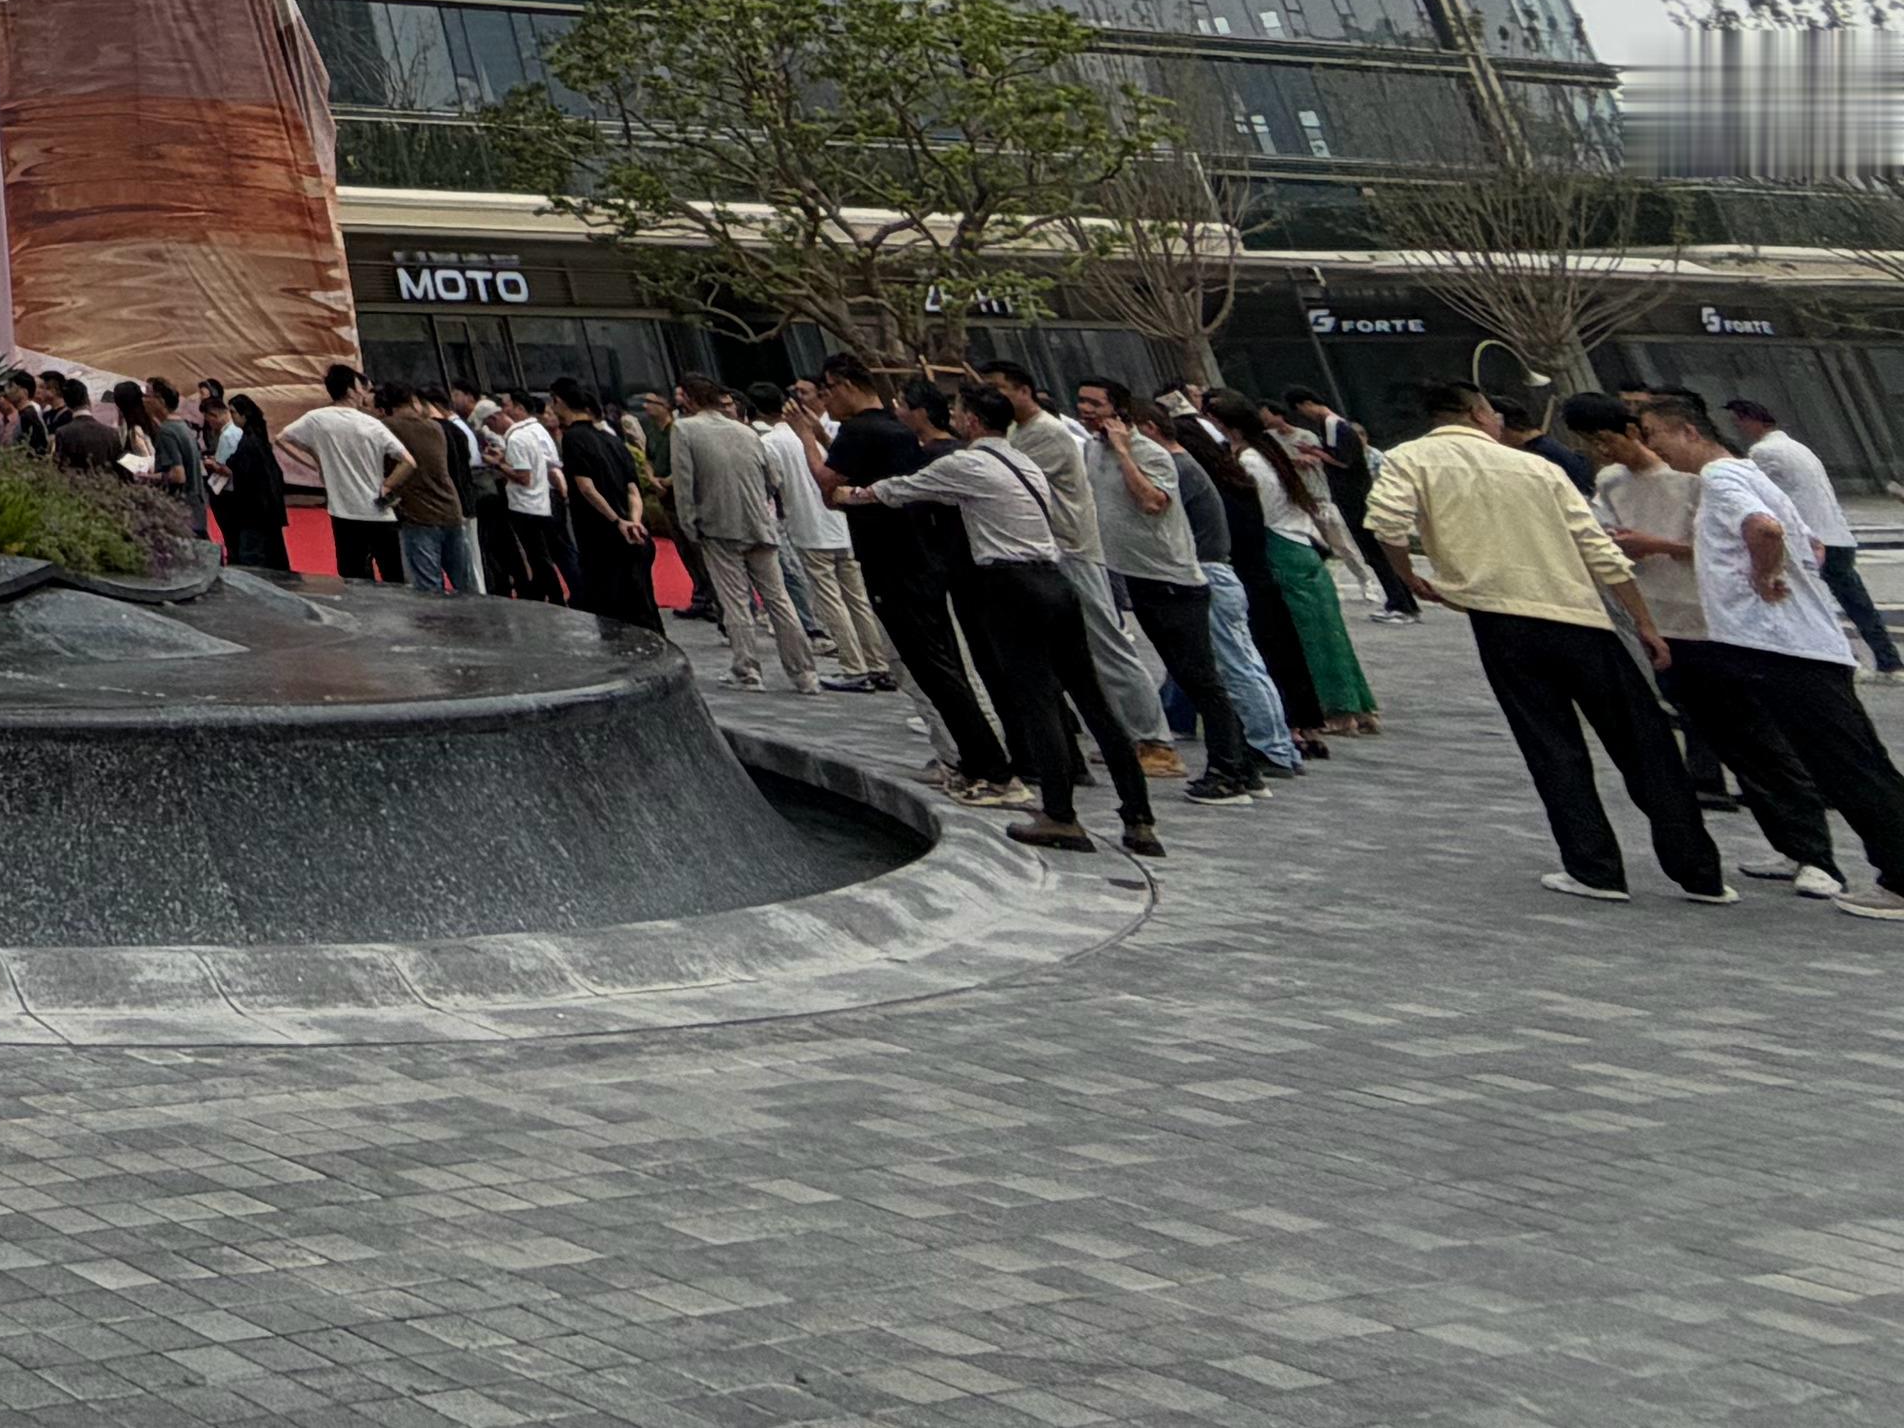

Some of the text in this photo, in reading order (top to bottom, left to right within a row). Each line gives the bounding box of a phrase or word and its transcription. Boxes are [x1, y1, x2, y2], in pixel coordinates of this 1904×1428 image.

[395, 267, 529, 303] MOTO
[1340, 319, 1425, 333] FORTE
[1723, 319, 1777, 336] FORTE
